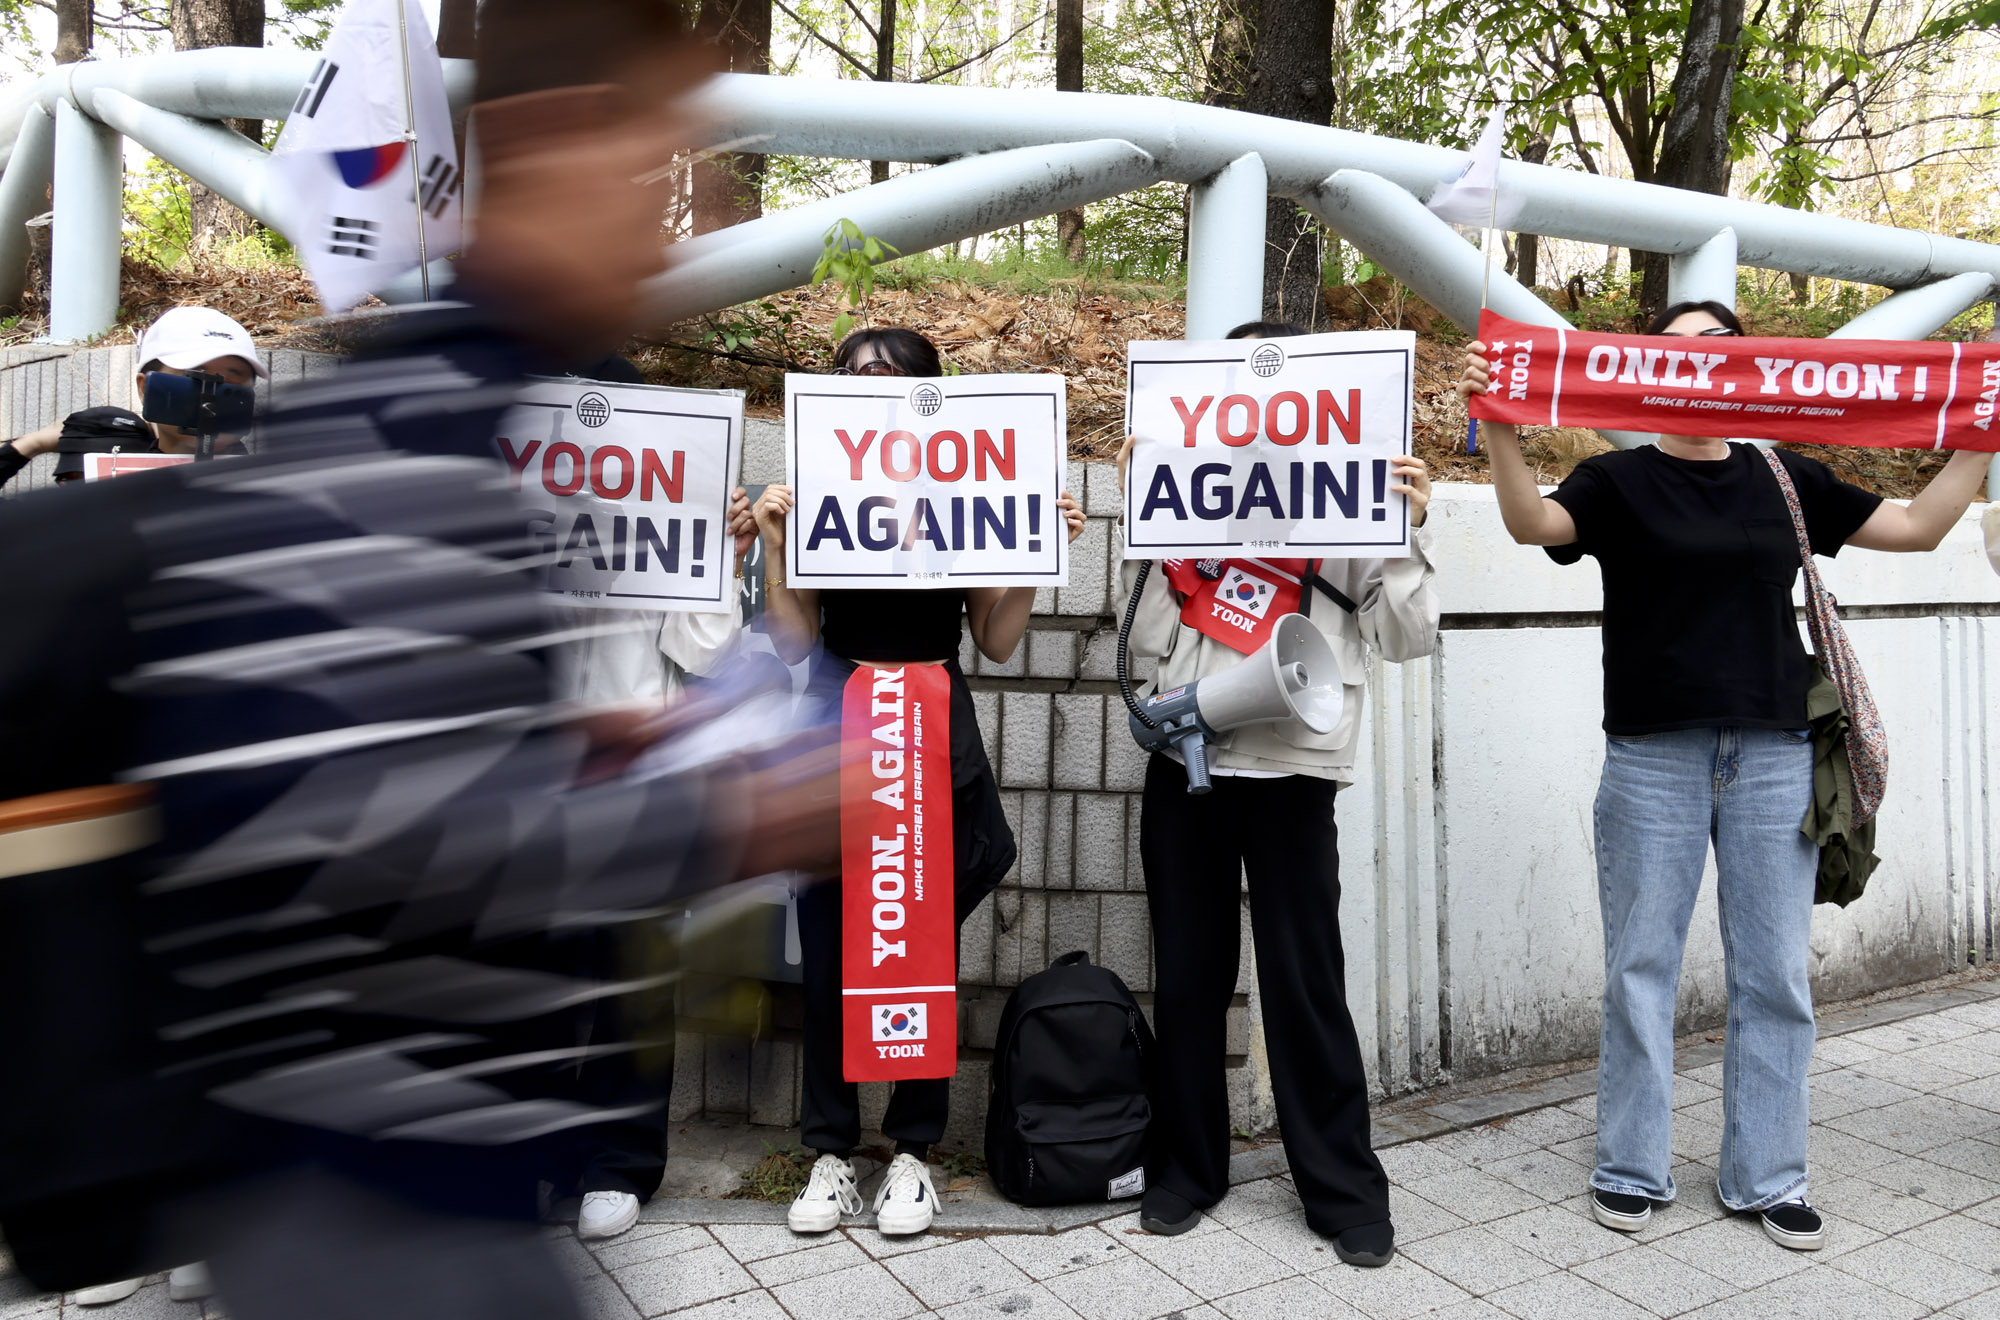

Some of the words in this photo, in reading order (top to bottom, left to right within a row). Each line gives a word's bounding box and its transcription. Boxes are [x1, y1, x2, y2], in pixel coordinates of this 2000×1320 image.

[1509, 340, 1533, 400] YOON
[1585, 345, 1736, 395] ONLY,
[1973, 360, 2000, 431] AGAIN
[1170, 389, 1361, 448] YOON
[1641, 395, 1688, 407] MAKE
[1688, 399, 1743, 411] KOREA
[1743, 403, 1797, 414] GREAT
[1797, 406, 1845, 416] AGAIN
[496, 437, 685, 504] YOON
[834, 429, 1016, 482] YOON
[1139, 459, 1387, 521] AGAIN!
[525, 508, 707, 577] GAIN!
[806, 494, 1041, 552] AGAIN!
[1250, 540, 1280, 548] 자유대학
[571, 589, 601, 599] 자유대학
[914, 571, 943, 580] 자유대학
[1196, 561, 1219, 578] STEAL
[1211, 603, 1257, 633] YOON
[872, 667, 904, 811] AGAIN
[913, 702, 923, 747] AGAIN
[914, 750, 923, 801] GREAT
[914, 804, 923, 855] KOREA
[872, 824, 909, 967] YOON,
[914, 859, 923, 901] MAKE
[875, 1043, 926, 1059] YOON
